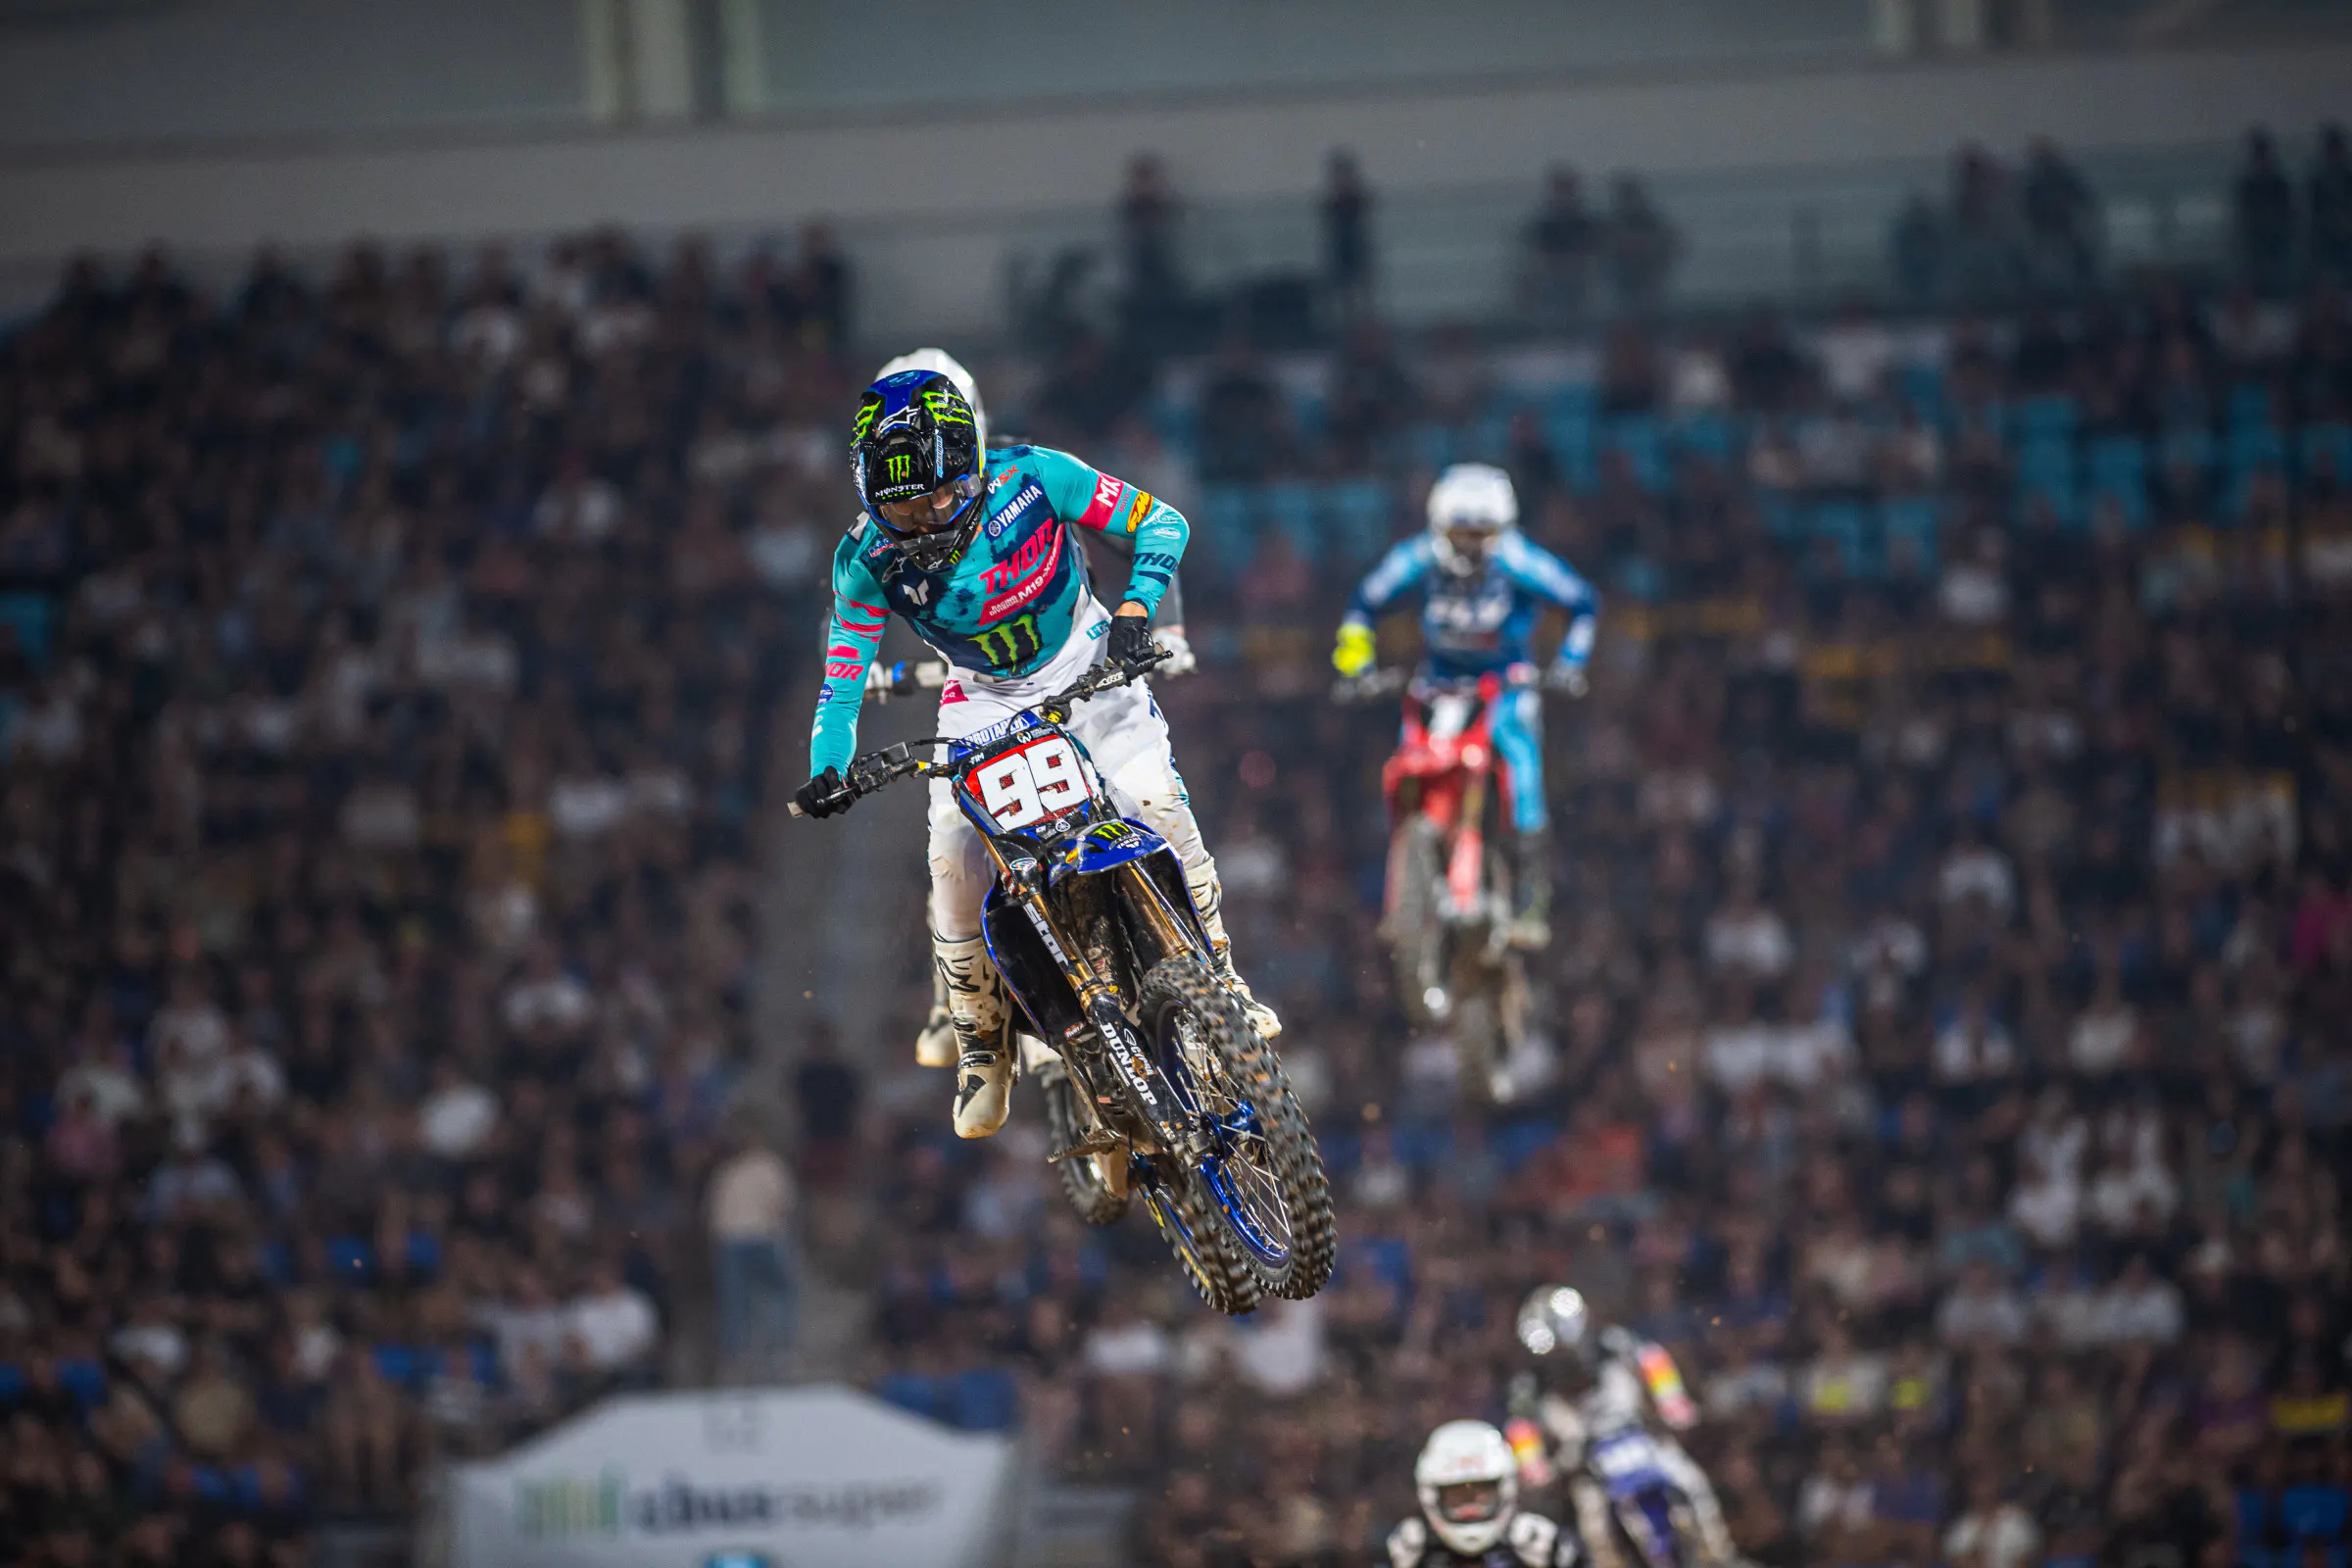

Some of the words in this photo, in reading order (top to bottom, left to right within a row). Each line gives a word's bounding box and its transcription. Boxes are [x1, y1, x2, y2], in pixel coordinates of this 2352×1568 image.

[875, 483, 925, 497] MONSTER
[997, 485, 1043, 527] YAMAHA
[979, 517, 1054, 595] THOR
[976, 737, 1089, 831] 99
[1100, 1022, 1157, 1105] DUNLOP
